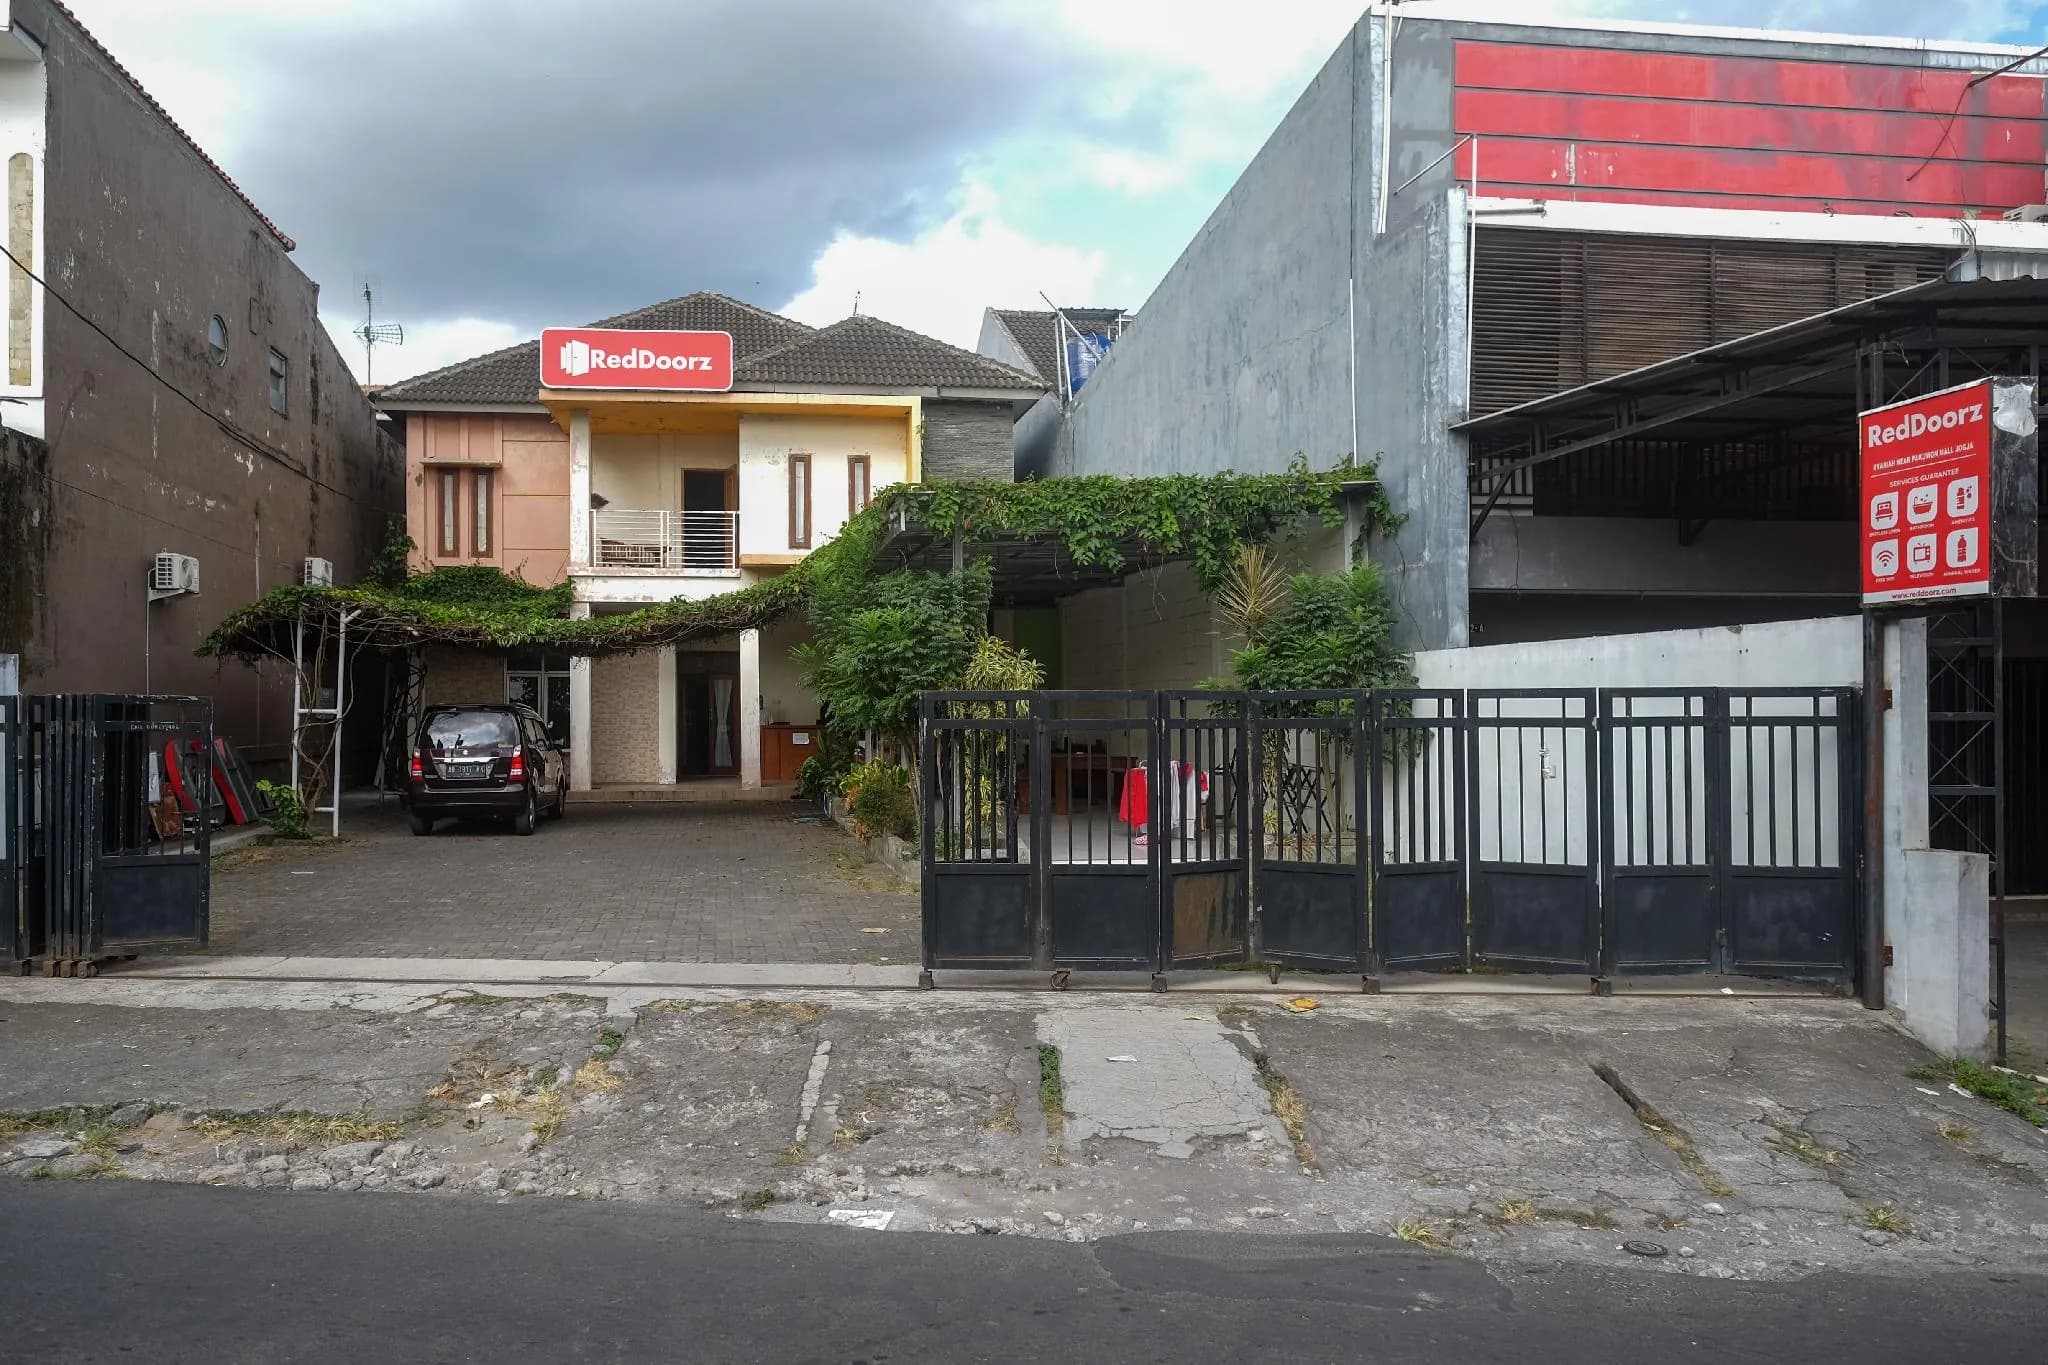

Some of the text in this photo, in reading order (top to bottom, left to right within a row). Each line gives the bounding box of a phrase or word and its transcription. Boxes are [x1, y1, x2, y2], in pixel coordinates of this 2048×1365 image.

[591, 348, 713, 371] RedDoorz
[1868, 403, 1984, 448] RedDoorz
[1896, 456, 1911, 467] NEAR
[1911, 450, 1939, 463] PAKUWON
[1939, 446, 1954, 457] MALL
[1955, 441, 1974, 453] JOGJA
[1889, 467, 1960, 488] SERVICES GUARANTEE
[1891, 587, 1957, 600] www.reddoorz.com
